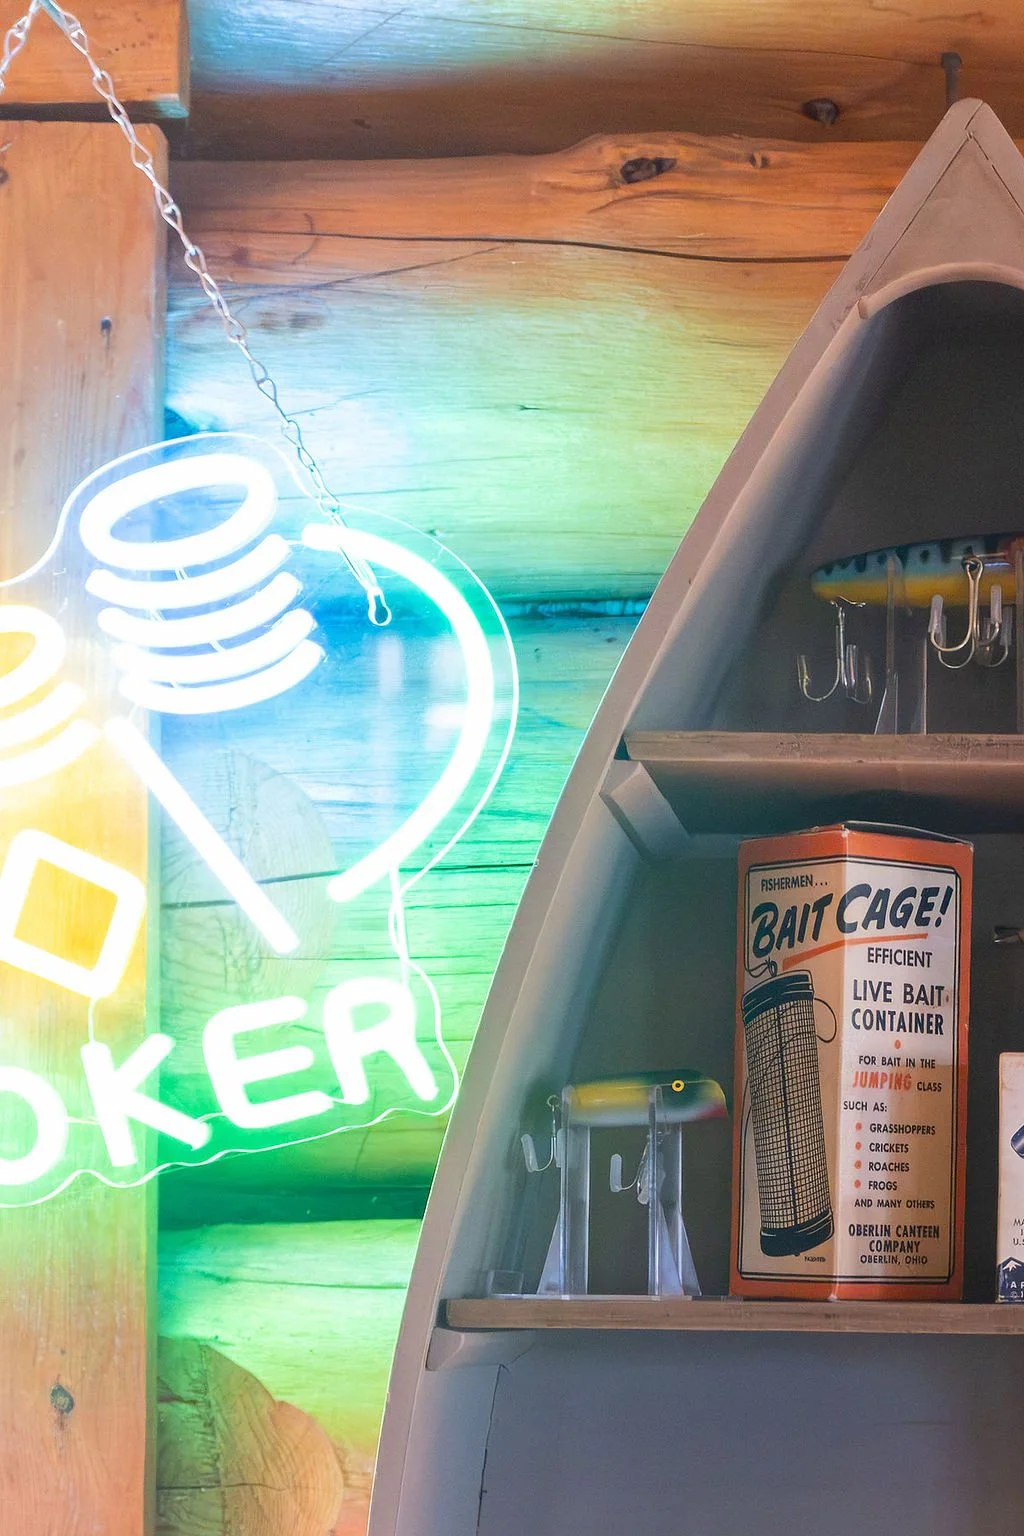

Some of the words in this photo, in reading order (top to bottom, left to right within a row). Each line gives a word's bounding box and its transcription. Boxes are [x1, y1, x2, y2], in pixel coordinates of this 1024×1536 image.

[761, 875, 828, 892] FISHERMEN...
[752, 893, 833, 958] BAIT
[836, 883, 954, 934] CAGE!
[867, 947, 933, 968] EFFICIENT
[853, 980, 893, 1003] LIVE
[903, 984, 945, 1007] BAIT
[851, 1008, 944, 1035] CONTAINER
[859, 1056, 876, 1065] FOR
[881, 1056, 901, 1067] BAIT
[906, 1058, 916, 1068] IN
[920, 1058, 936, 1069] THE
[852, 1071, 912, 1090] JUMPING
[917, 1081, 942, 1092] CLASS
[843, 1101, 868, 1111] SUCH
[873, 1102, 888, 1112] AS:
[869, 1123, 936, 1135] GRASSHOPPERS
[869, 1142, 909, 1153] CRICKETS
[868, 1161, 910, 1172] ROACHES
[868, 1180, 898, 1191] FROGS
[854, 1199, 873, 1208] AND
[877, 1199, 902, 1208] MANY
[906, 1200, 935, 1209] OTHERS
[848, 1224, 891, 1237] OBERLIN
[896, 1224, 940, 1238] CANTEEN
[869, 1240, 921, 1254] COMPANY
[860, 1255, 901, 1265] OBERLIN,
[905, 1255, 928, 1265] OHIO
[1010, 1281, 1017, 1289] A
